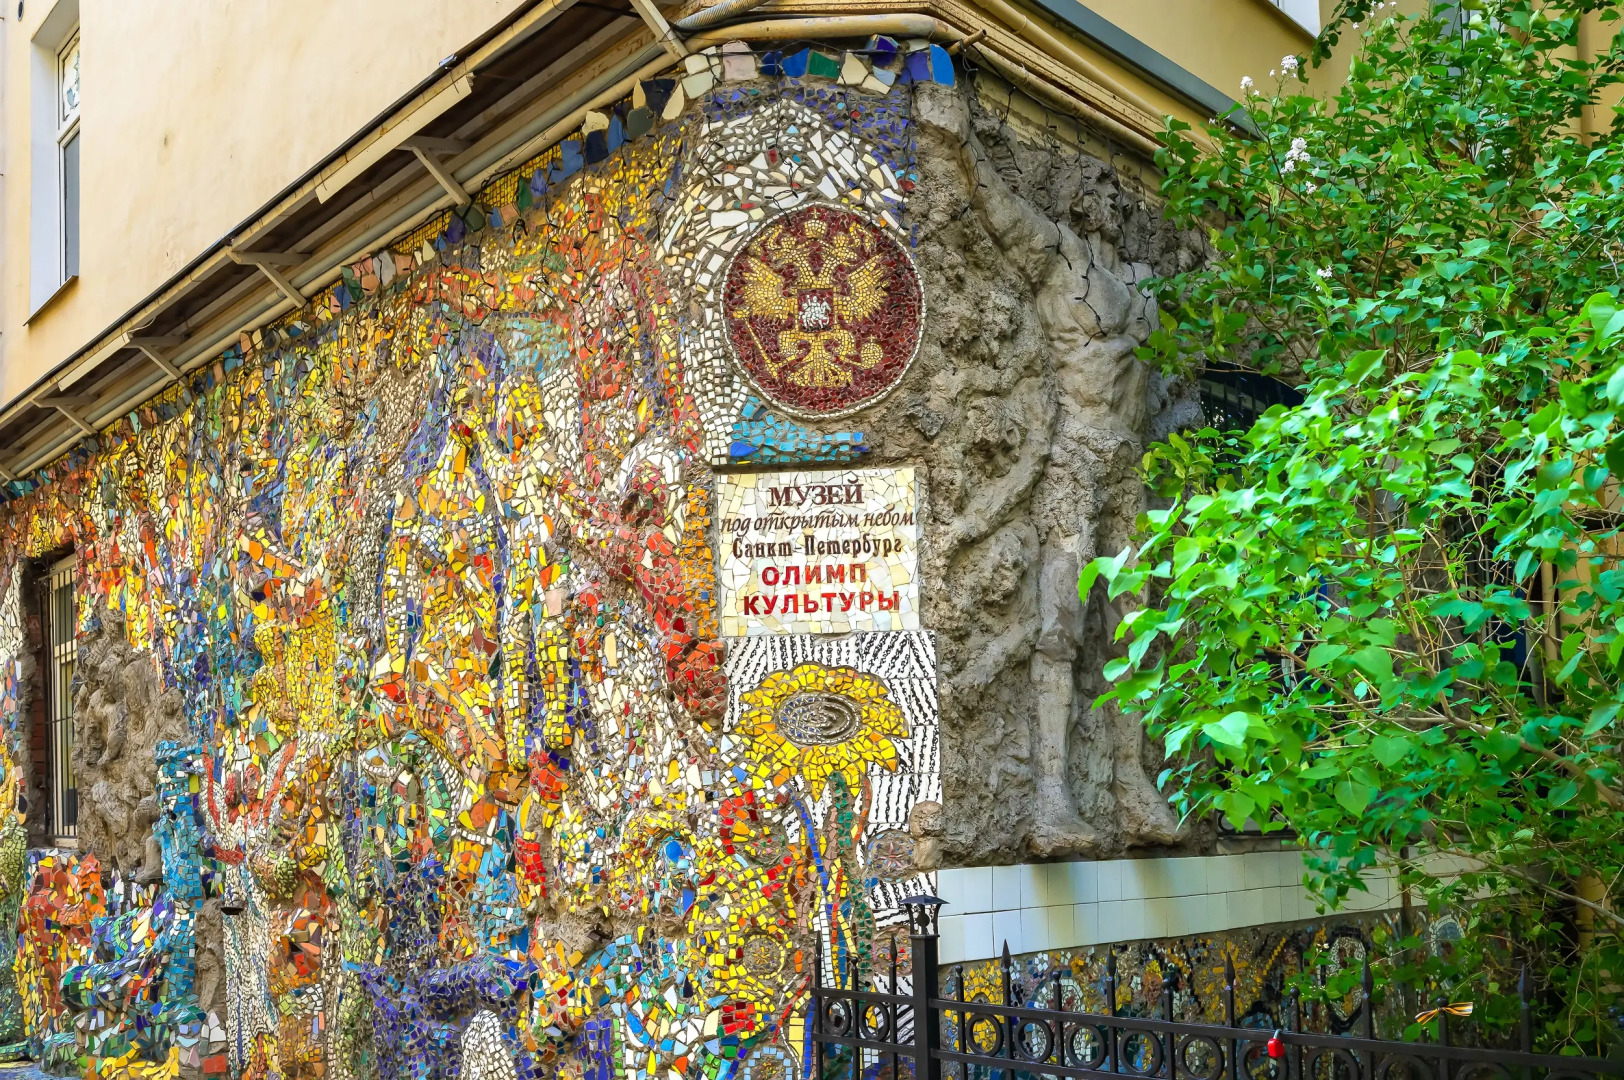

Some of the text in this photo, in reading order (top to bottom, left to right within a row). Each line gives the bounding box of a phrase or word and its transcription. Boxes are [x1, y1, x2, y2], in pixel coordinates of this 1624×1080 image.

[768, 475, 865, 507] МУЗЕЙ
[721, 503, 915, 537] под открытым небом
[732, 533, 903, 559] Санкт-Петербург
[761, 563, 867, 586] ОЛИМП
[743, 590, 900, 616] КУЛЬТУРЫ
